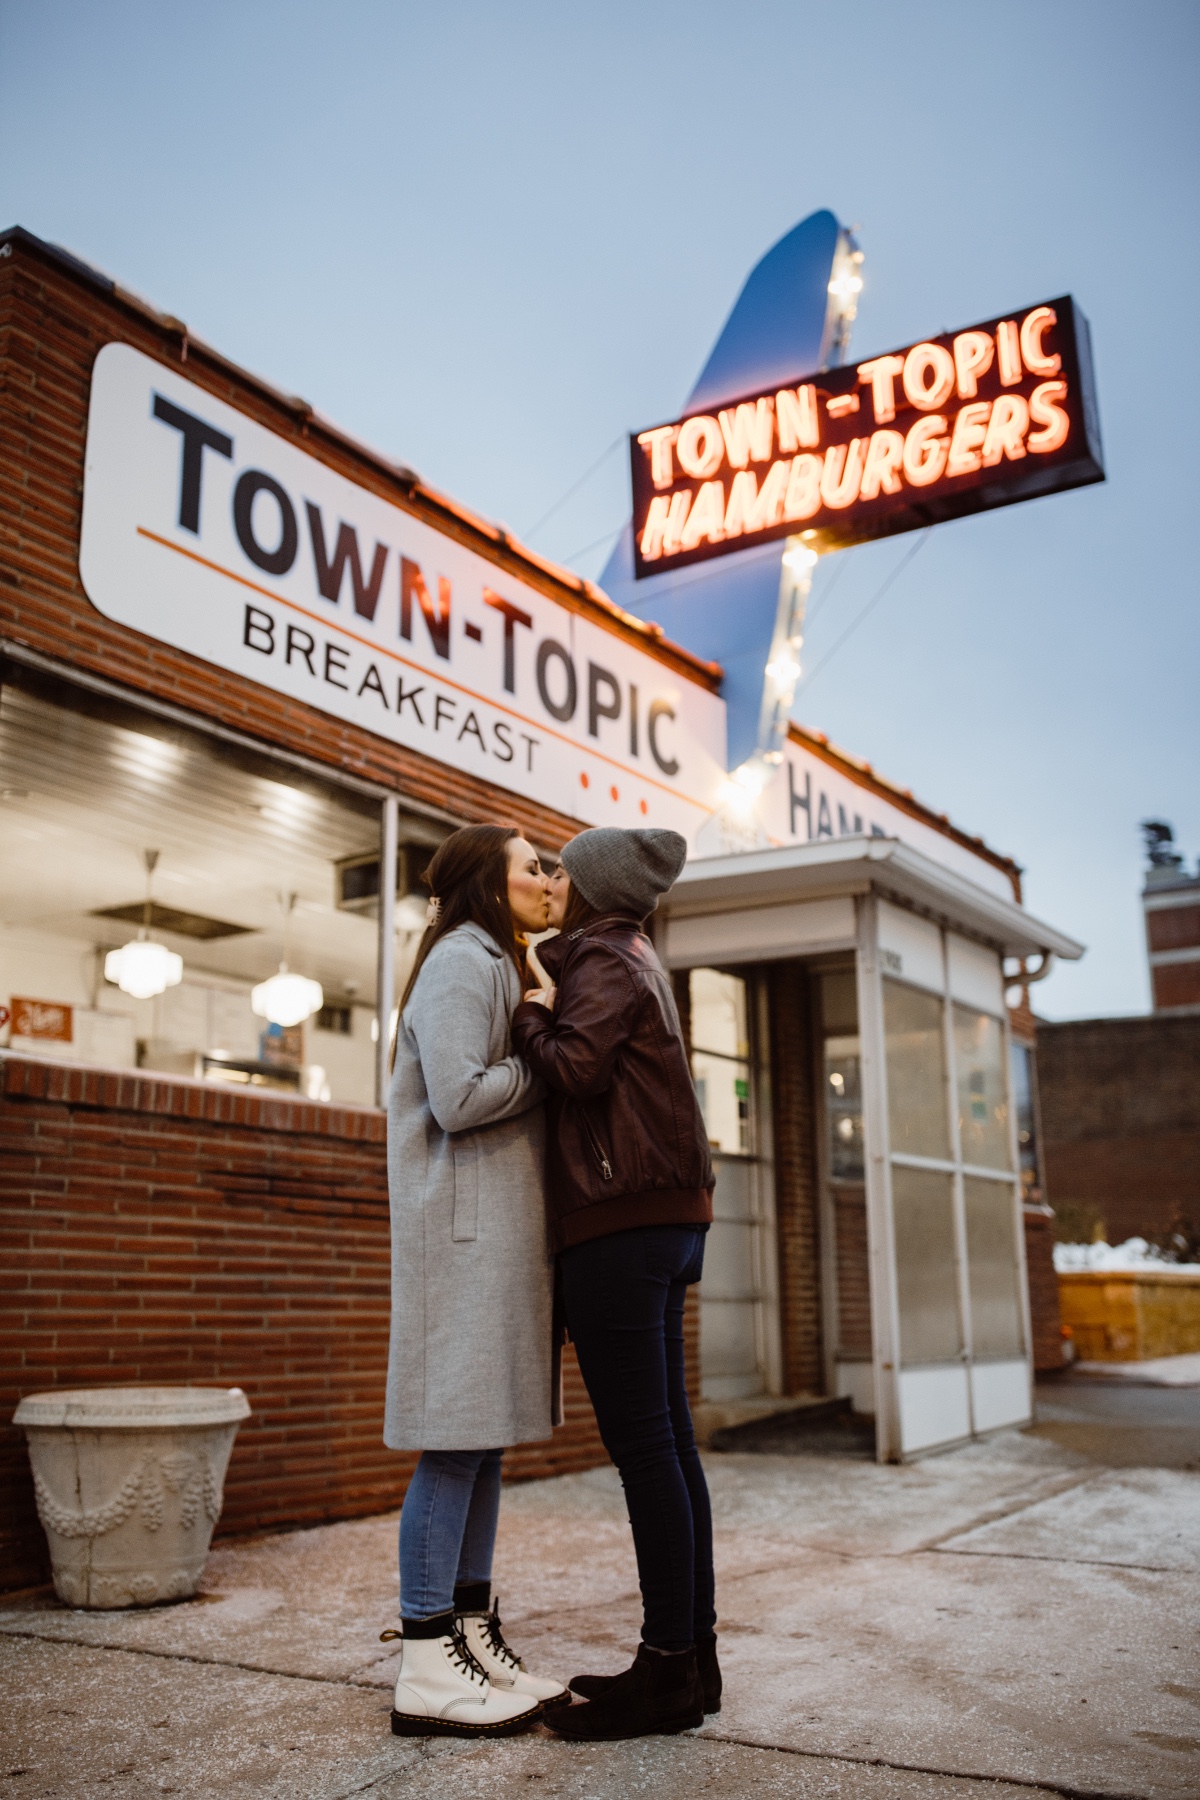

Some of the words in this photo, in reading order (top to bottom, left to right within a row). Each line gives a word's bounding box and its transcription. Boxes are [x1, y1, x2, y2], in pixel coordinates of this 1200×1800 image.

[637, 307, 1061, 489] TOWN-TOPIC
[639, 380, 1070, 561] HAMBURGERS
[152, 391, 680, 778] TOWN-TOPIC
[243, 603, 541, 774] BREAKFAST
[788, 760, 886, 839] HAM
